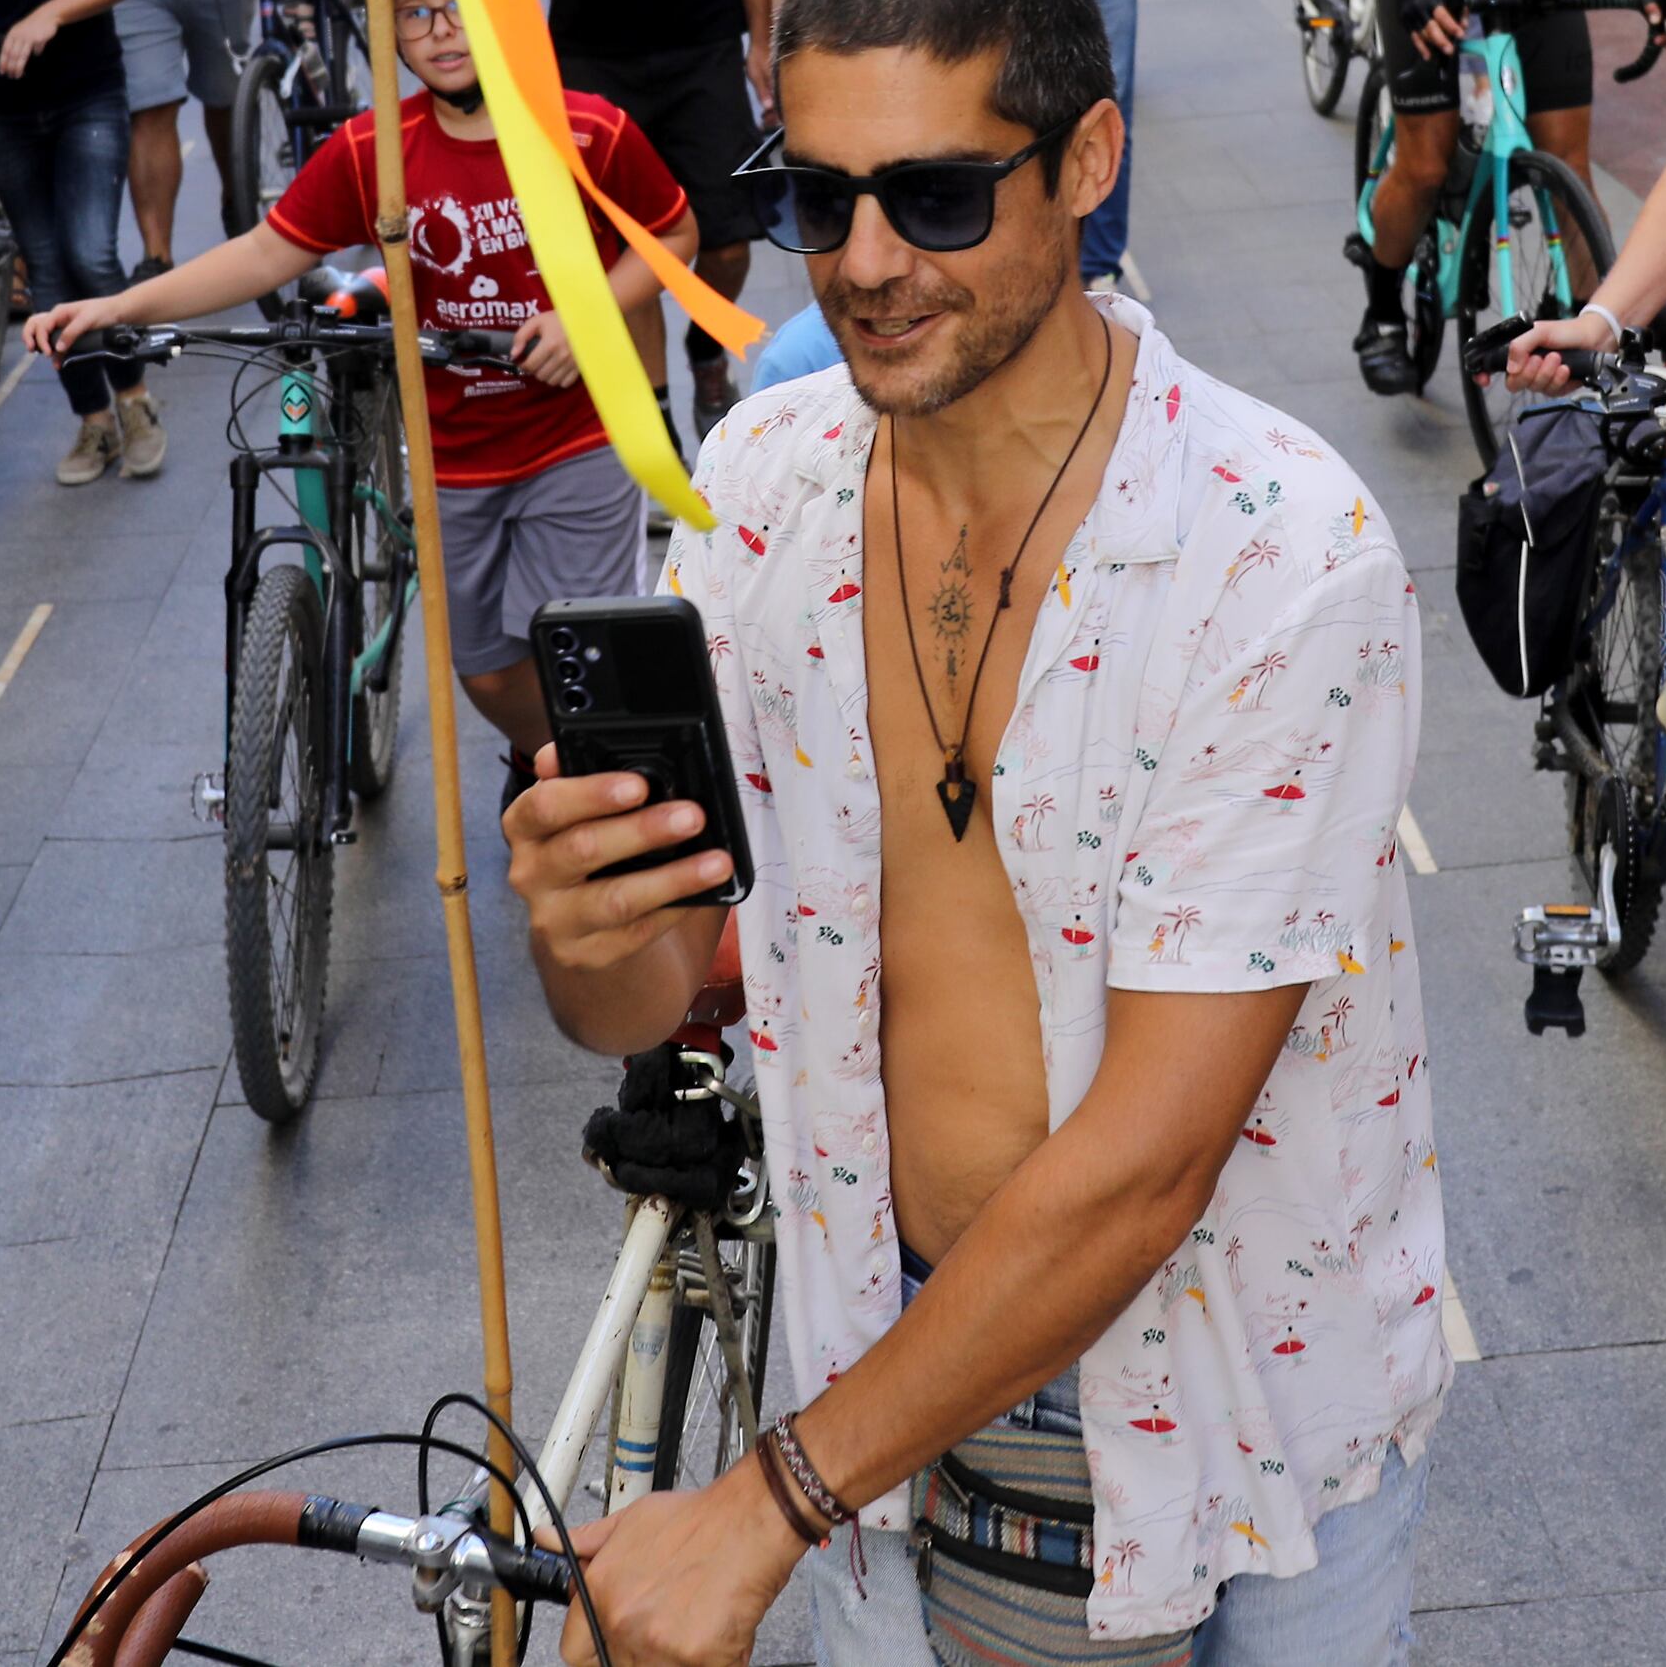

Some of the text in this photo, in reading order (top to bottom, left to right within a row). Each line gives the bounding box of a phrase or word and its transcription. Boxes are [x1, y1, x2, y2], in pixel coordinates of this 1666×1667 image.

[476, 221, 491, 239] A
[480, 236, 505, 256] EN
[437, 298, 541, 319] aeromax
